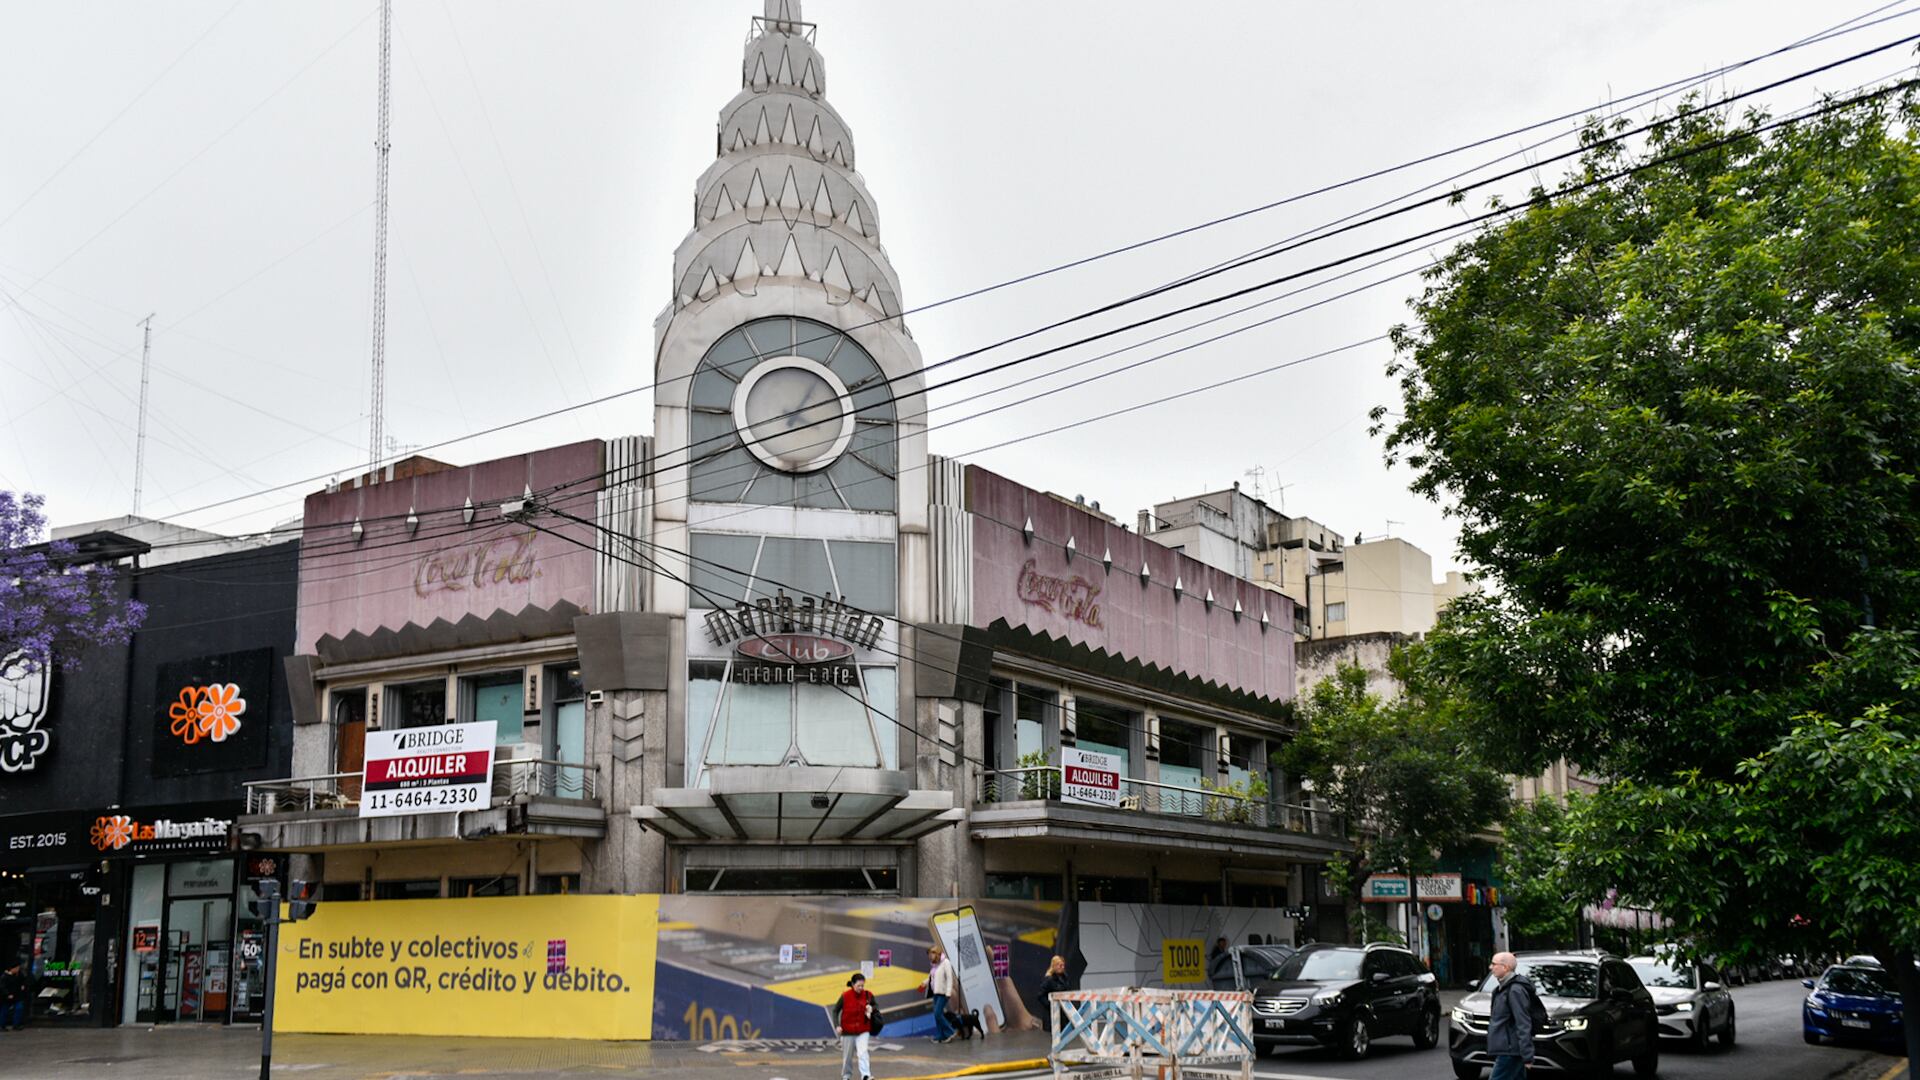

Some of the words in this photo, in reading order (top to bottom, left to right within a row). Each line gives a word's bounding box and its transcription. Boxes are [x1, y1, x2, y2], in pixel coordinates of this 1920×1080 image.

[762, 639, 829, 660] Club
[743, 665, 794, 685] grand
[809, 666, 850, 685] cafe
[407, 728, 464, 748] BRIDGE
[0, 730, 48, 771] CP
[1083, 753, 1108, 766] BRIDGE
[386, 755, 466, 779] ALQUILER
[1072, 769, 1113, 787] ALQUILER
[371, 787, 477, 809] 11-6464-2330
[1068, 786, 1116, 801] 11-6464-2330
[10, 835, 35, 849] EST.
[37, 832, 67, 847] 2015
[299, 938, 323, 959] En
[329, 936, 384, 959] subte
[391, 941, 402, 961] y
[408, 935, 518, 959] colectivos
[1168, 945, 1200, 968] TODO
[296, 966, 345, 993] pagá
[351, 971, 388, 989] con
[395, 967, 432, 993] QR,
[438, 967, 516, 992] crédito
[523, 971, 537, 993] y
[1169, 968, 1200, 978] CONECTADO
[684, 1001, 761, 1040] 100%
